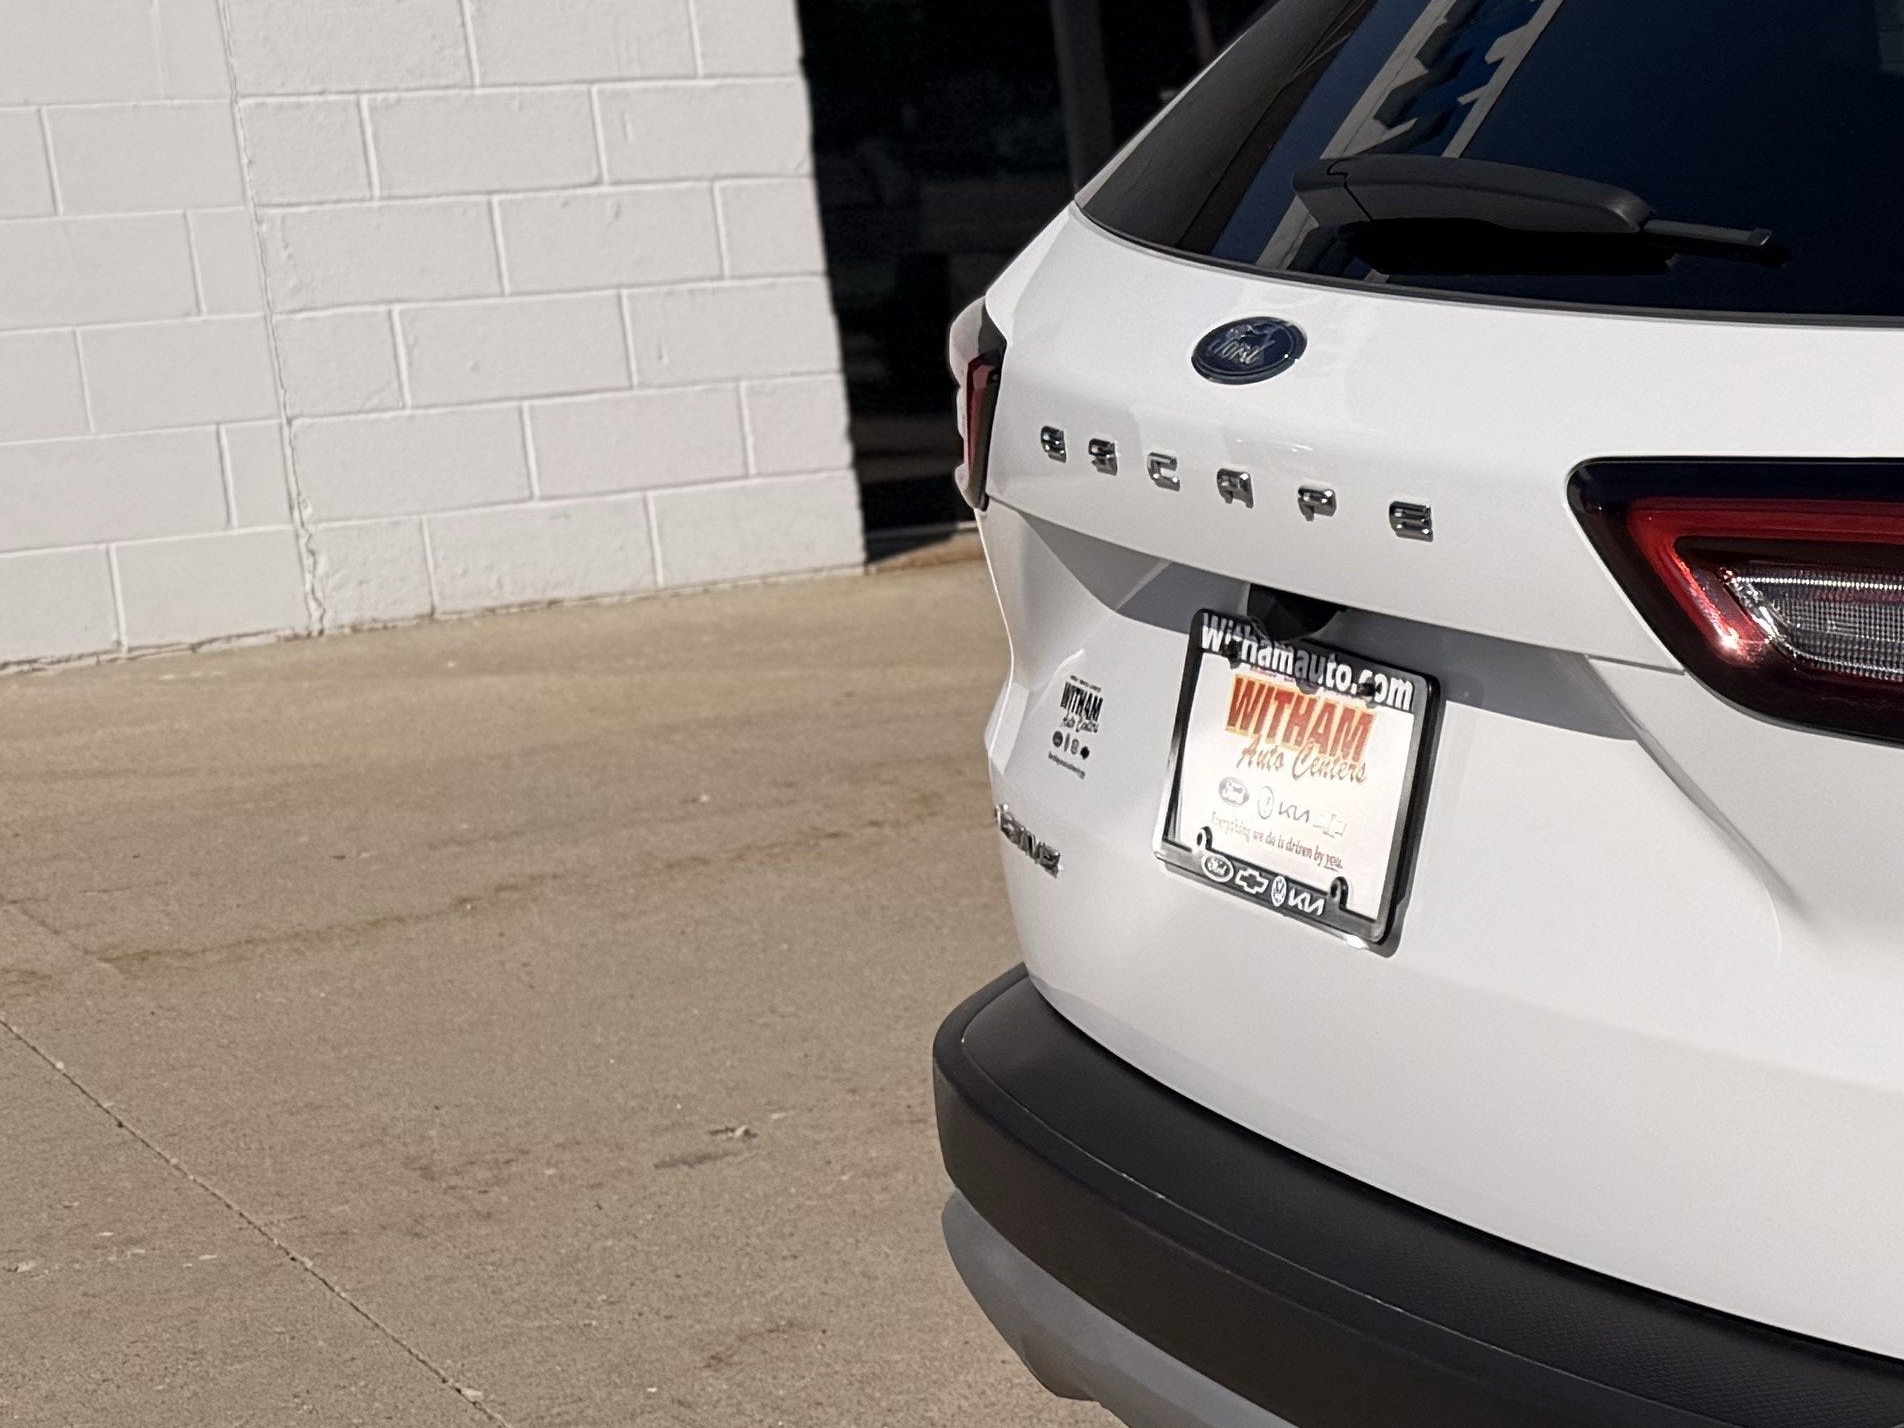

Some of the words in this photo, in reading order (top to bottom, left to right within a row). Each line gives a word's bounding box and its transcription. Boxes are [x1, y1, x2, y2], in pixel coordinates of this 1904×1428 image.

[1040, 425, 1434, 542] ESCAPE
[1225, 675, 1375, 763] WITHAM
[1236, 735, 1285, 772] Auto
[1291, 742, 1367, 784] Centers
